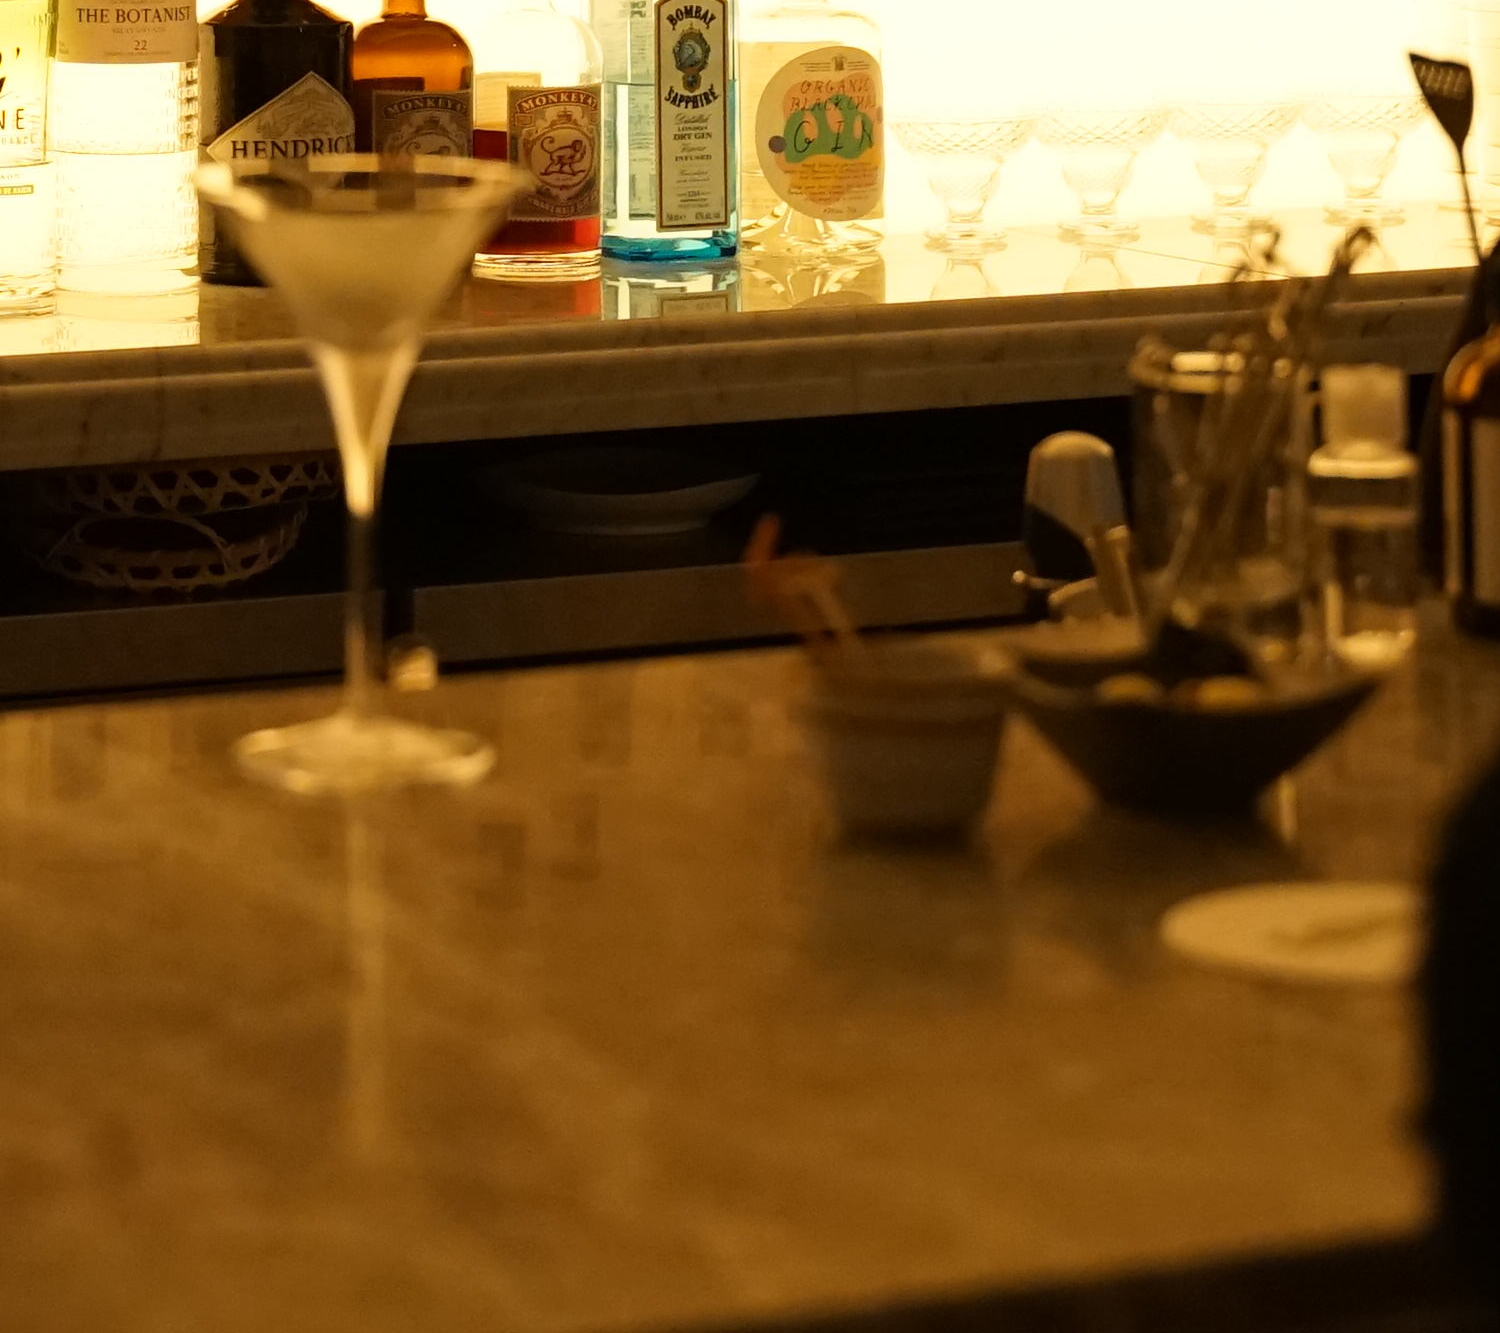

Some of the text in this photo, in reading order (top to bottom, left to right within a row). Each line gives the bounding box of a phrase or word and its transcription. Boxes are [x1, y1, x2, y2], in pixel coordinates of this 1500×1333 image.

[76, 6, 191, 25] THE BOTANIST
[664, 3, 718, 33] BOMBAY
[133, 38, 149, 51] 22
[521, 90, 586, 114] MONKEY
[663, 82, 722, 110] SAPPHIRE
[672, 132, 713, 141] DRY GIN
[793, 118, 875, 155] GIN
